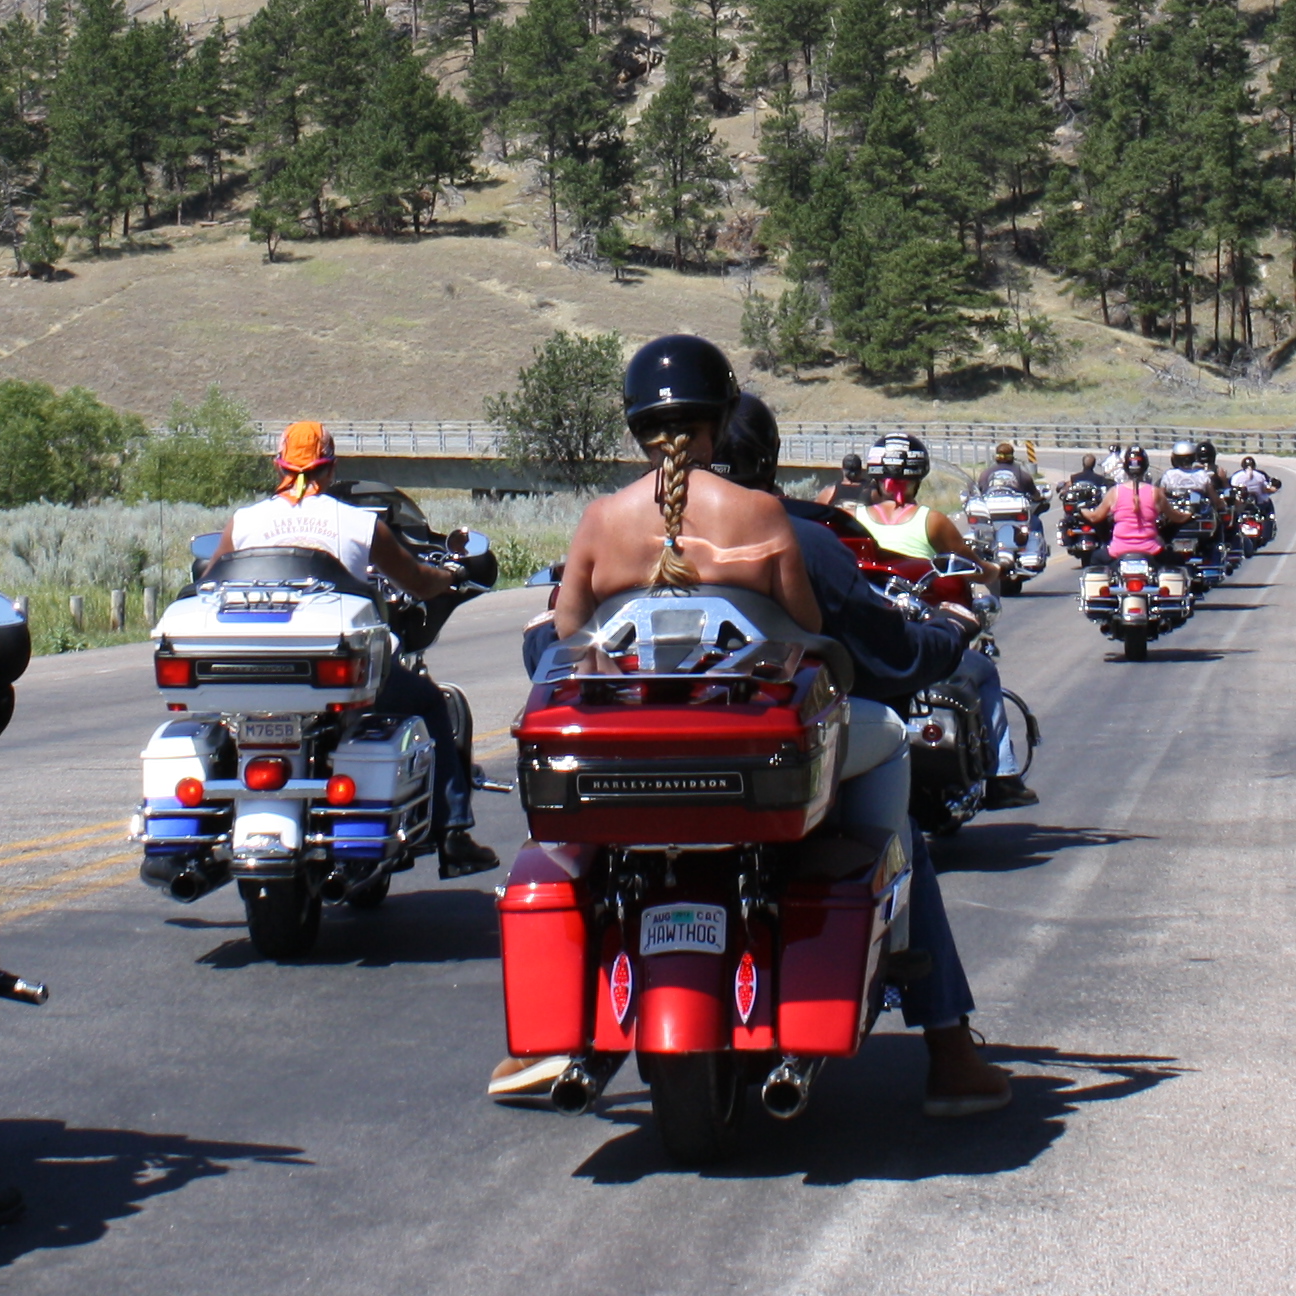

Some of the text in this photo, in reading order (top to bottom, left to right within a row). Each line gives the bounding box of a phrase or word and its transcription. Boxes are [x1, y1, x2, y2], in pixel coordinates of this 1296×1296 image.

[273, 517, 329, 528] LAS VEGAS
[245, 724, 294, 737] M765B
[653, 912, 671, 923] AUG
[696, 911, 720, 923] CAL
[647, 923, 717, 945] HAWTHOG
